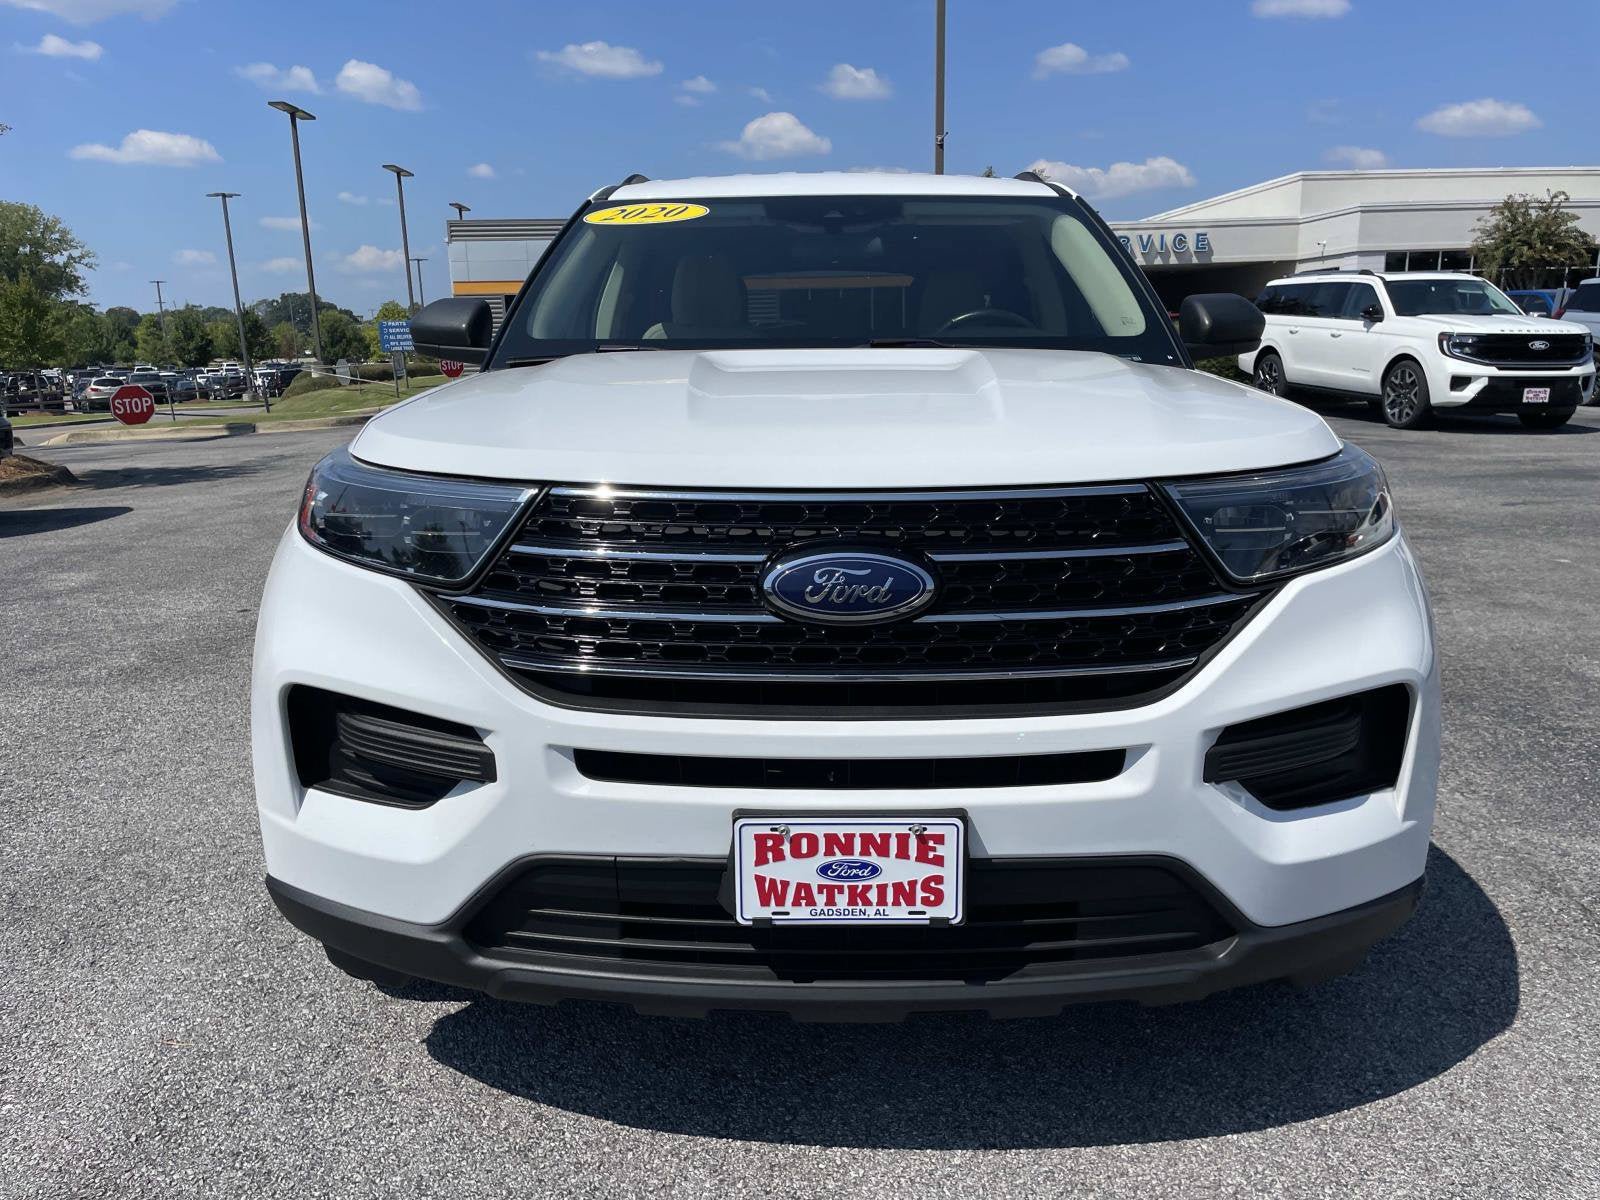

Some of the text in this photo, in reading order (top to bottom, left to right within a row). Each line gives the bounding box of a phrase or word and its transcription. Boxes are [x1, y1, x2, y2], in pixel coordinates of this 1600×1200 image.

[600, 206, 689, 221] 2020
[441, 360, 462, 370] STOP
[114, 398, 151, 414] STOP
[805, 567, 894, 604] Ford
[753, 833, 945, 867] RONNIE
[827, 860, 872, 878] Ford
[753, 874, 945, 907] WATKINS
[809, 908, 889, 918] GADSDEN, AL
